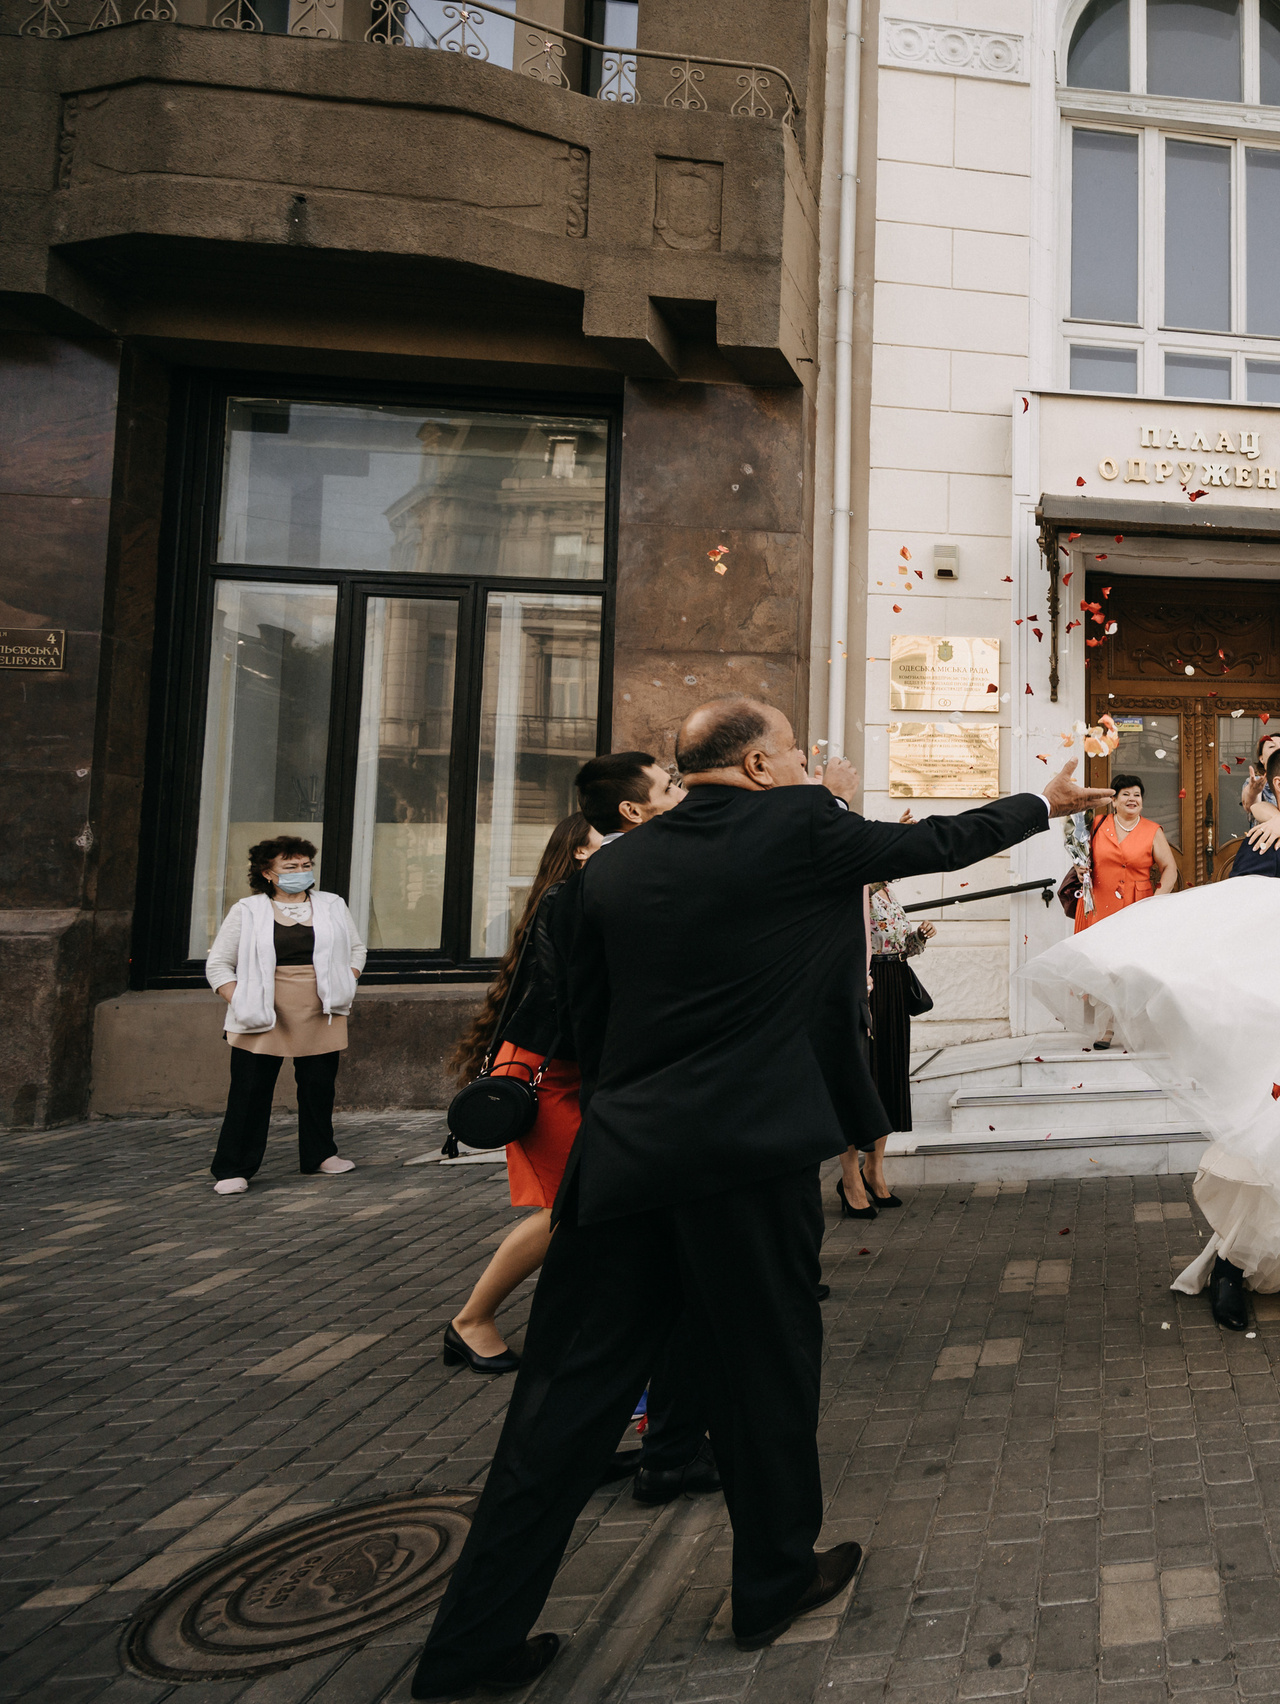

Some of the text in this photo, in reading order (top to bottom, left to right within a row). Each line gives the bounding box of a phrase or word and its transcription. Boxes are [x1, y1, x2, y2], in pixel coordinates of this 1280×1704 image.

[1140, 424, 1261, 460] ПАЛАЦ
[46, 633, 57, 644] 4
[899, 664, 936, 672] ОДЕСЬКА
